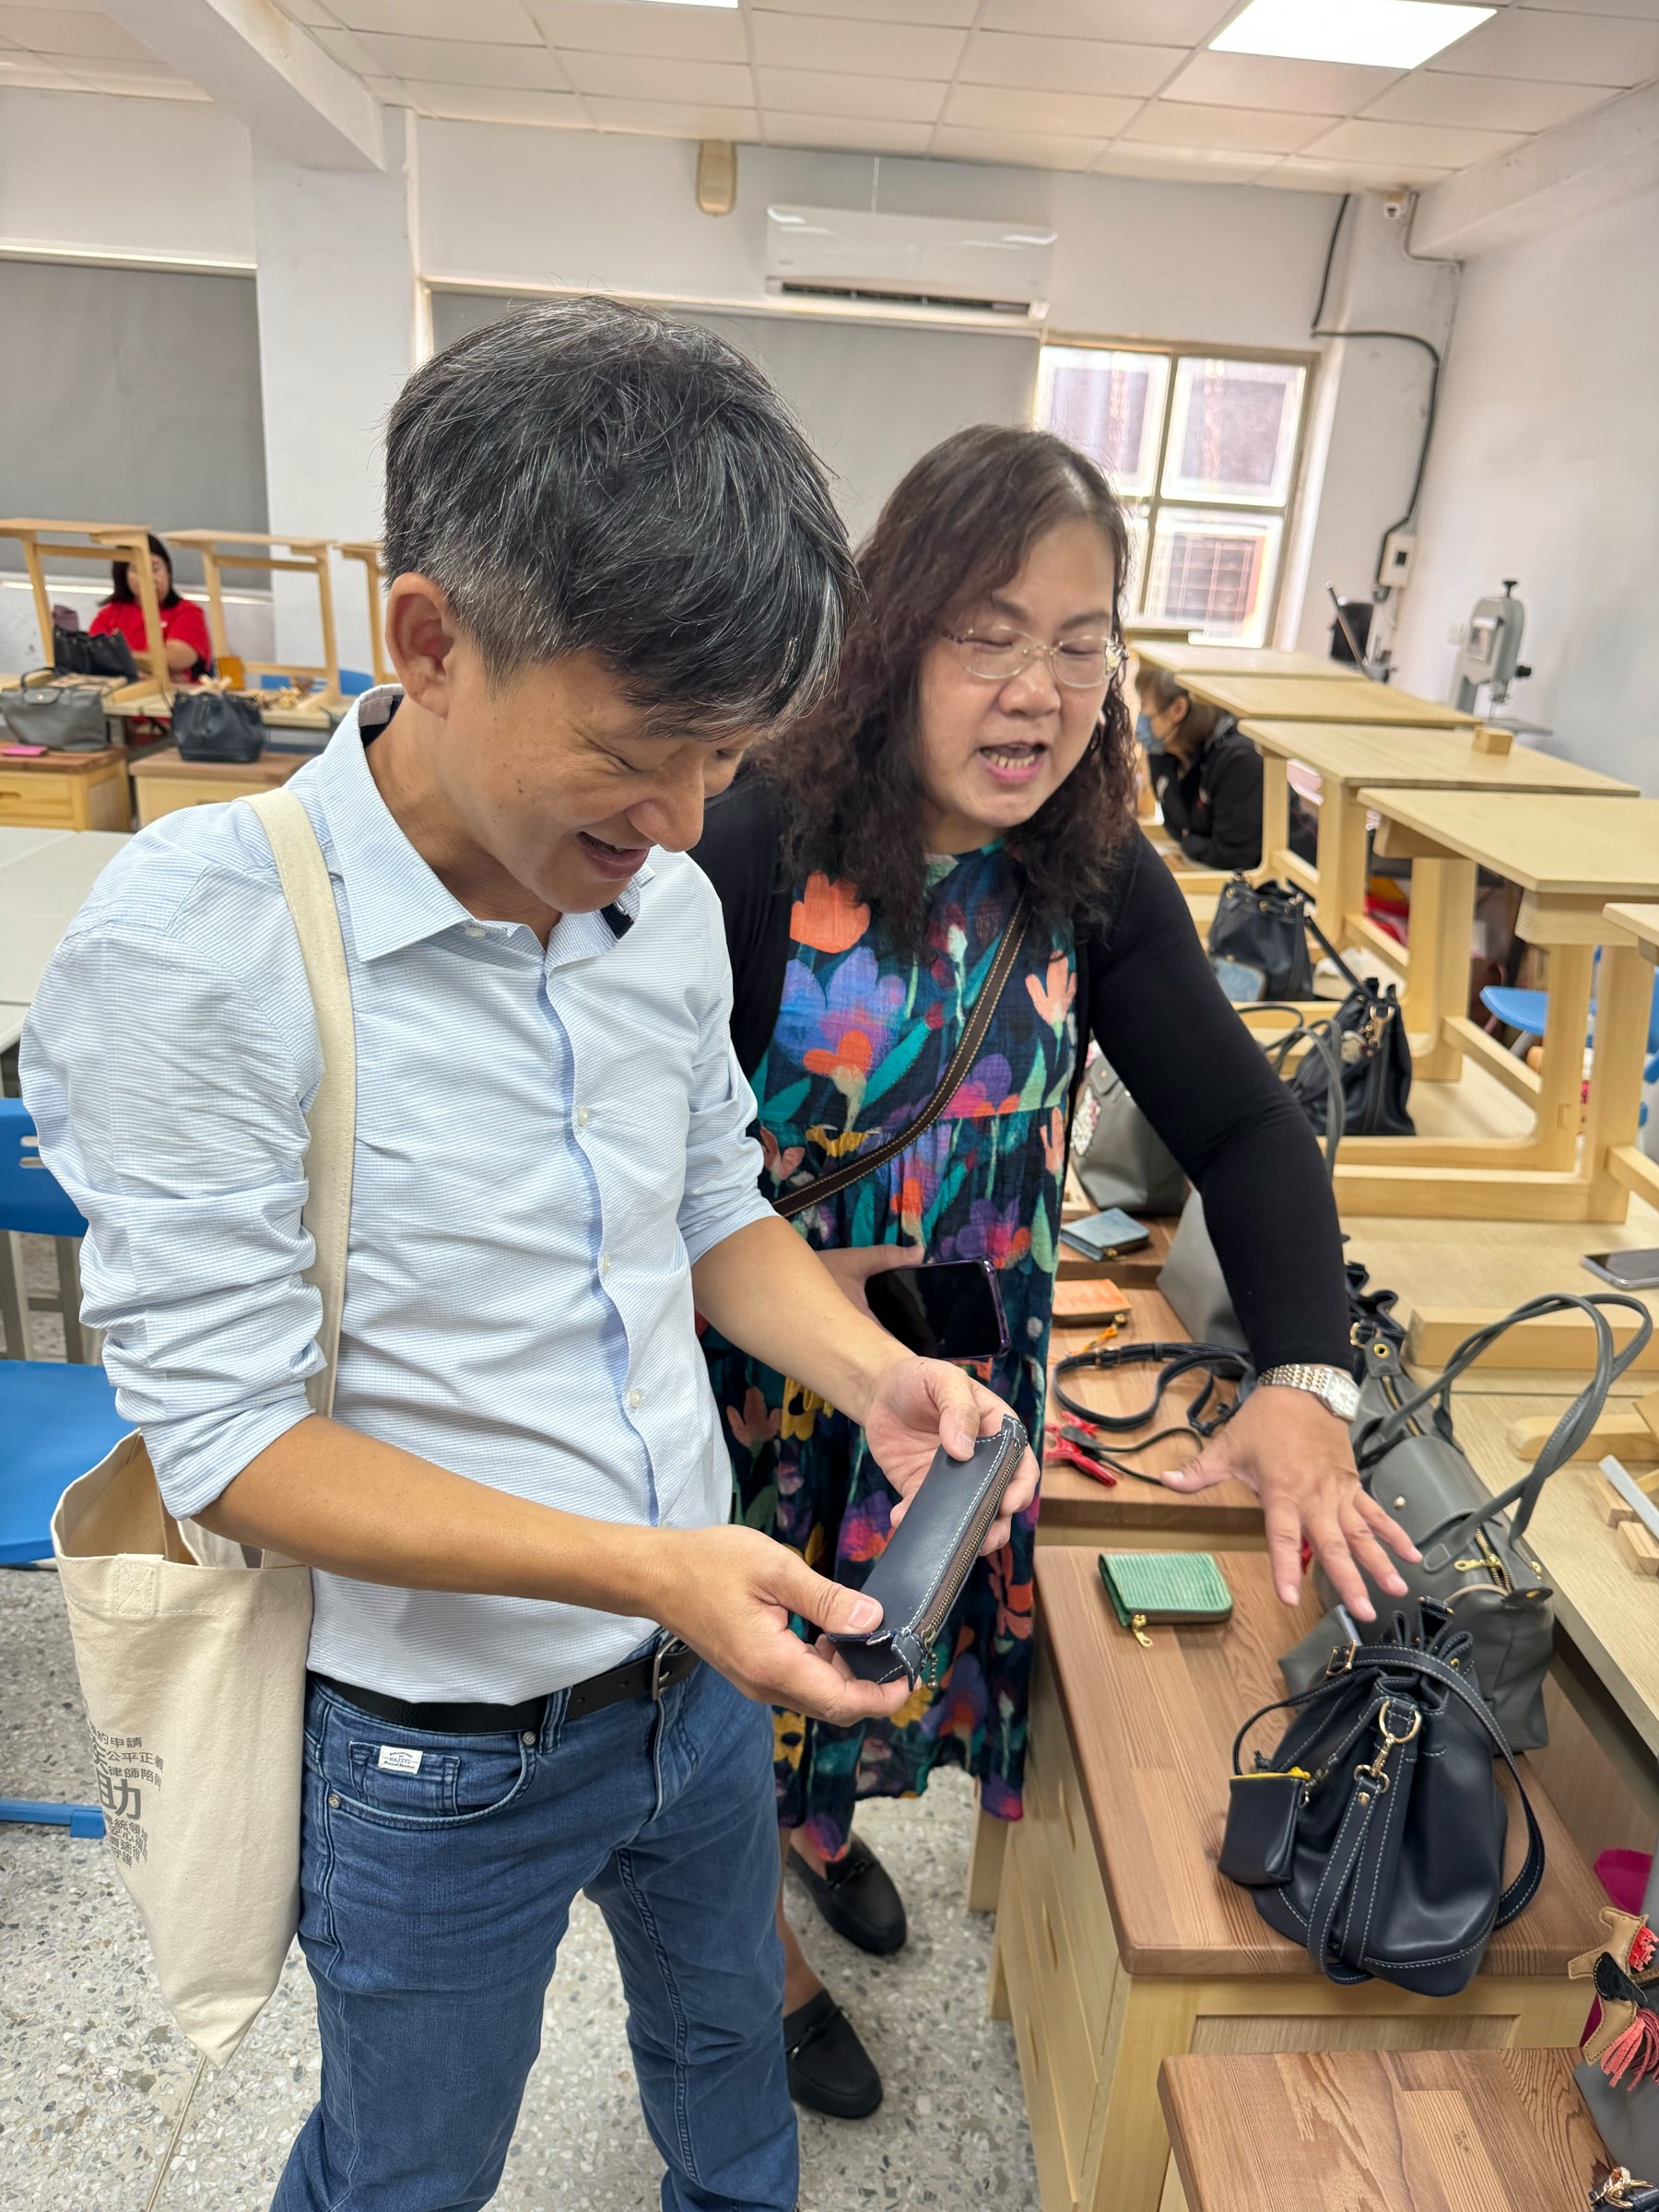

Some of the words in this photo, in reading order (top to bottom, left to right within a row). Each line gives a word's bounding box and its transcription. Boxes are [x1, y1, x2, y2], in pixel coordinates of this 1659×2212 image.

[90, 1721, 143, 1748] 約申請
[96, 1767, 142, 1820] 助
